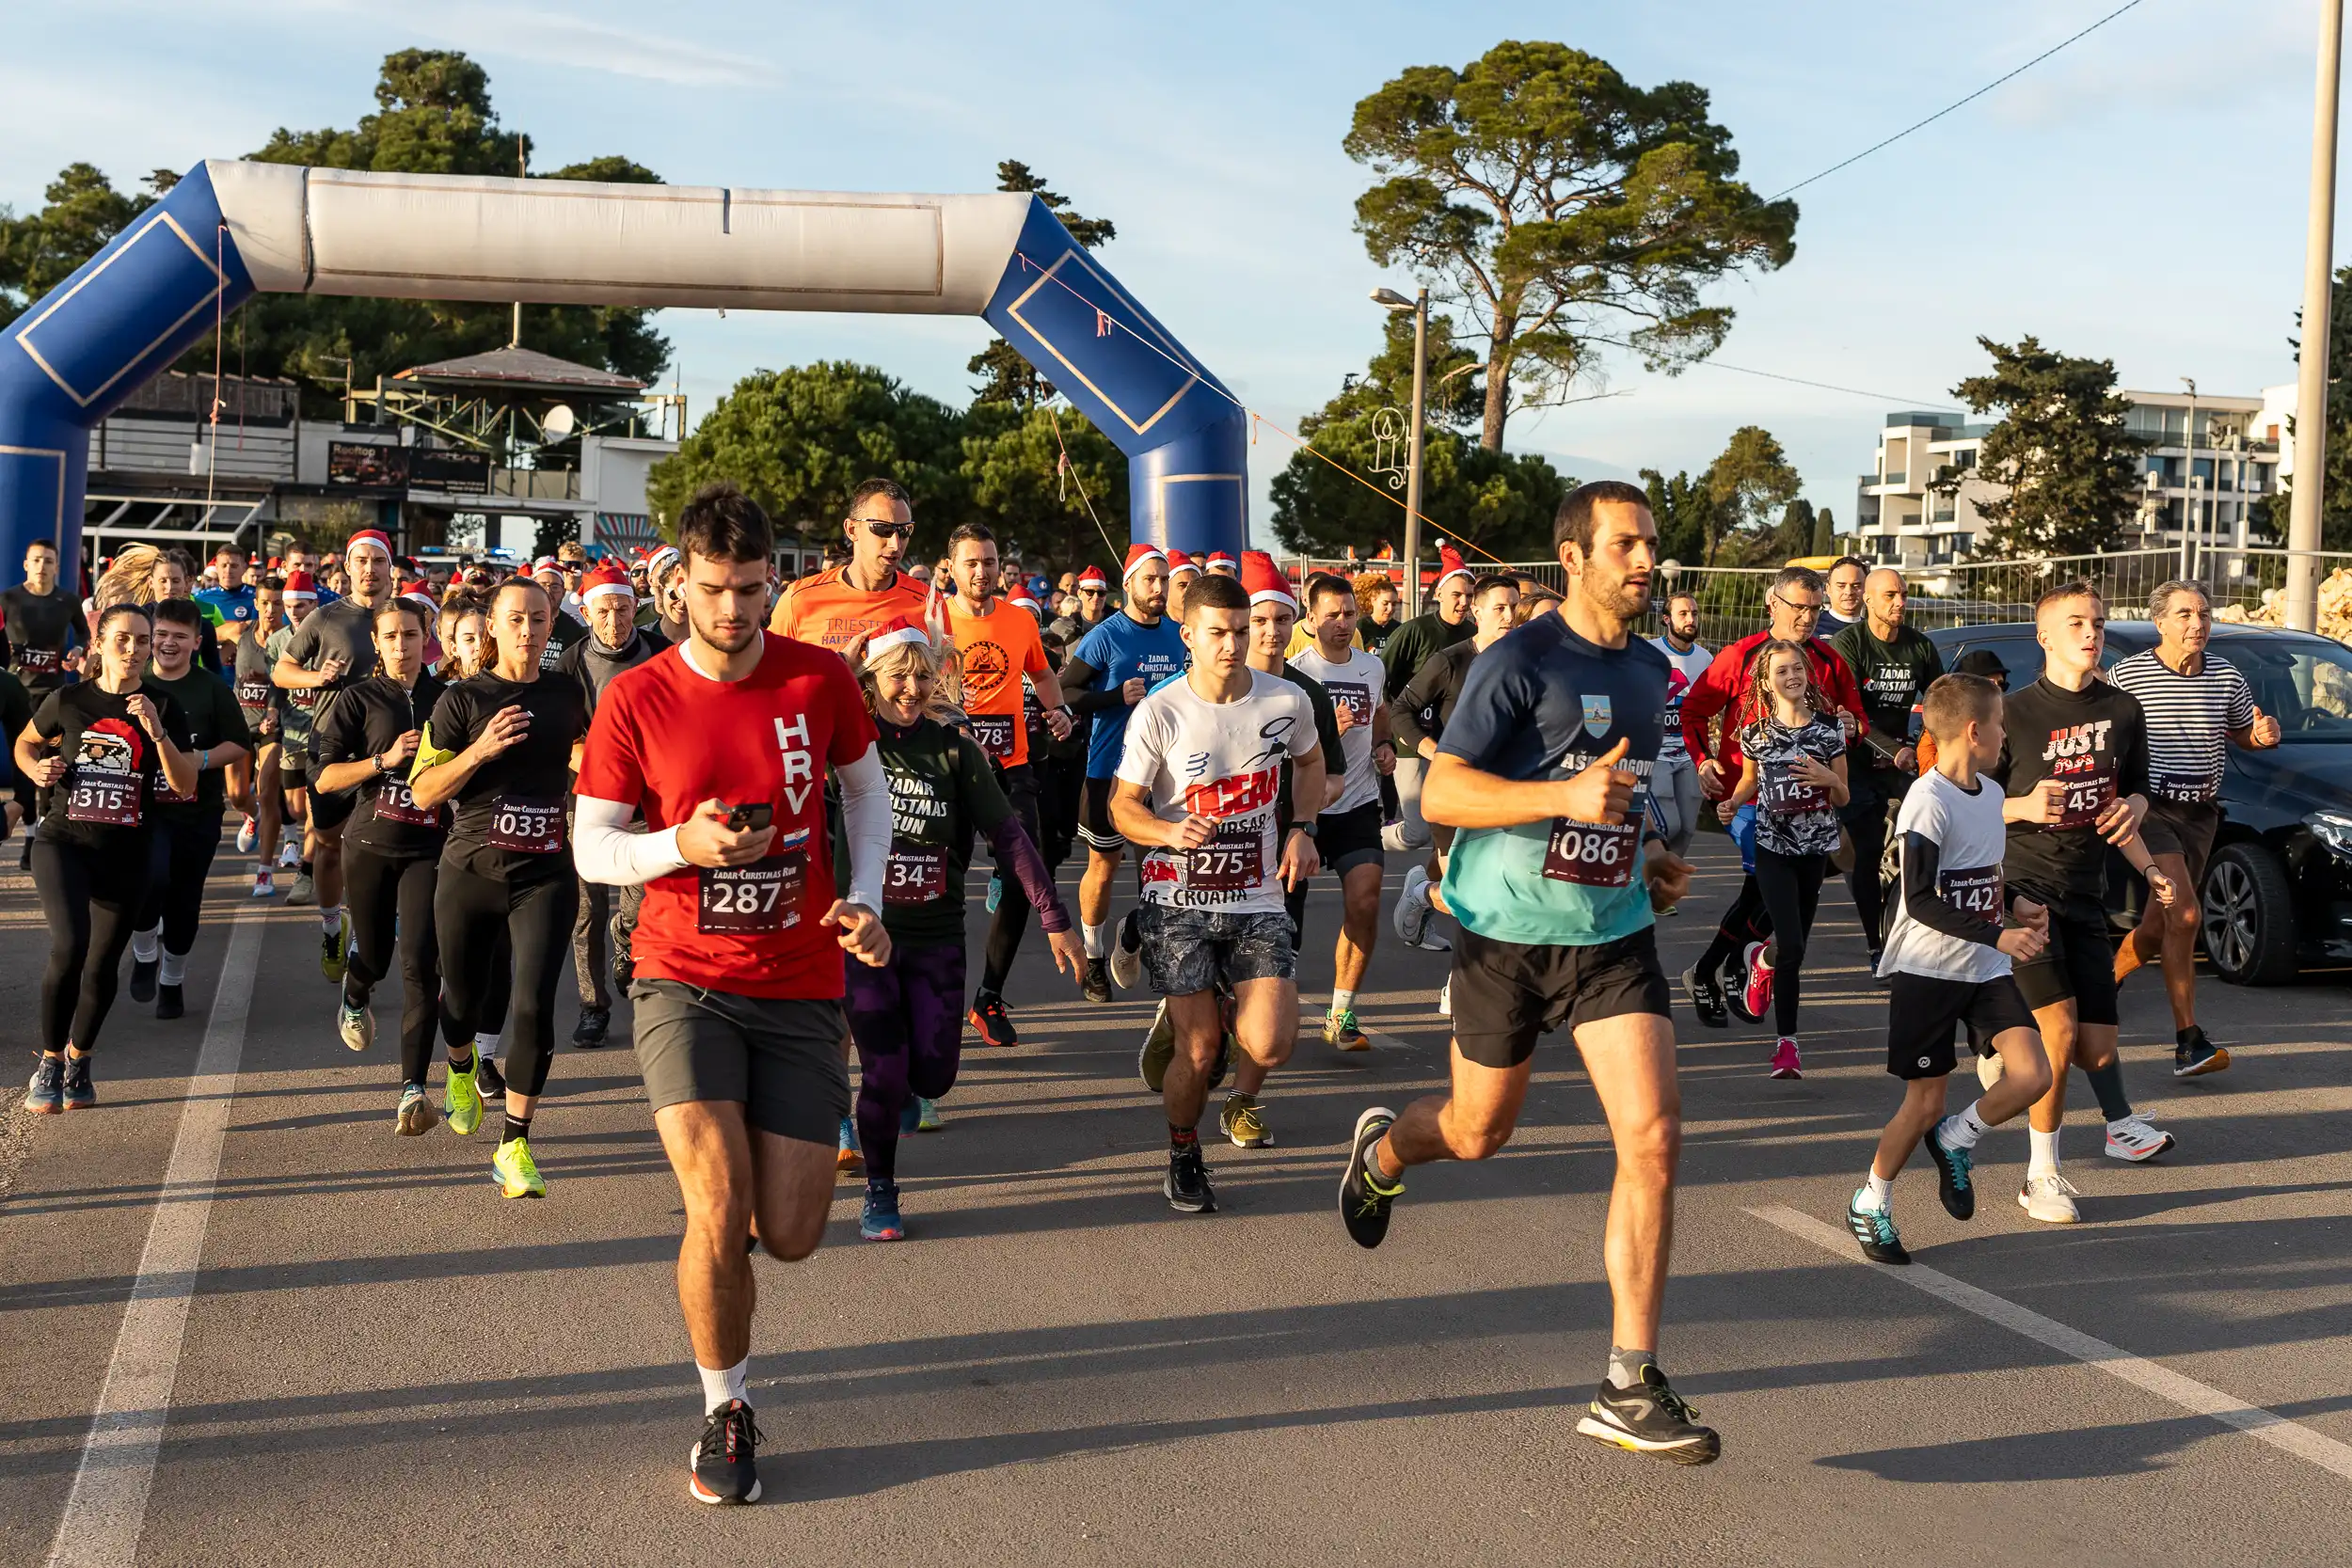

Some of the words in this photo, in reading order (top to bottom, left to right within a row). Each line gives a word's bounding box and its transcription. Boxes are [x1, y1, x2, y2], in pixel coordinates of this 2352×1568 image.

[334, 444, 376, 456] Rooftop
[25, 653, 50, 666] 147
[1137, 661, 1177, 673] CHRISTMAS
[1148, 654, 1169, 663] ZADAR
[1864, 678, 1916, 691] CHRISTMAS
[1879, 668, 1911, 679] ZADAR
[244, 688, 267, 701] 047
[1879, 691, 1904, 703] RUN
[1664, 714, 1682, 725] 00
[2042, 720, 2112, 761] JUST
[773, 713, 813, 816] HRV
[78, 788, 122, 809] 315
[388, 786, 421, 811] 19
[1775, 782, 1813, 801] 143
[2068, 788, 2099, 812] 45
[888, 792, 948, 817] RISTMAS
[500, 813, 547, 837] 033
[892, 812, 927, 835] RUN
[1559, 831, 1620, 865] 086
[1197, 852, 1244, 875] 275
[882, 863, 924, 888] 34
[712, 882, 782, 913] 287
[1173, 888, 1248, 906] CROATIA
[1951, 887, 1994, 911] 142
